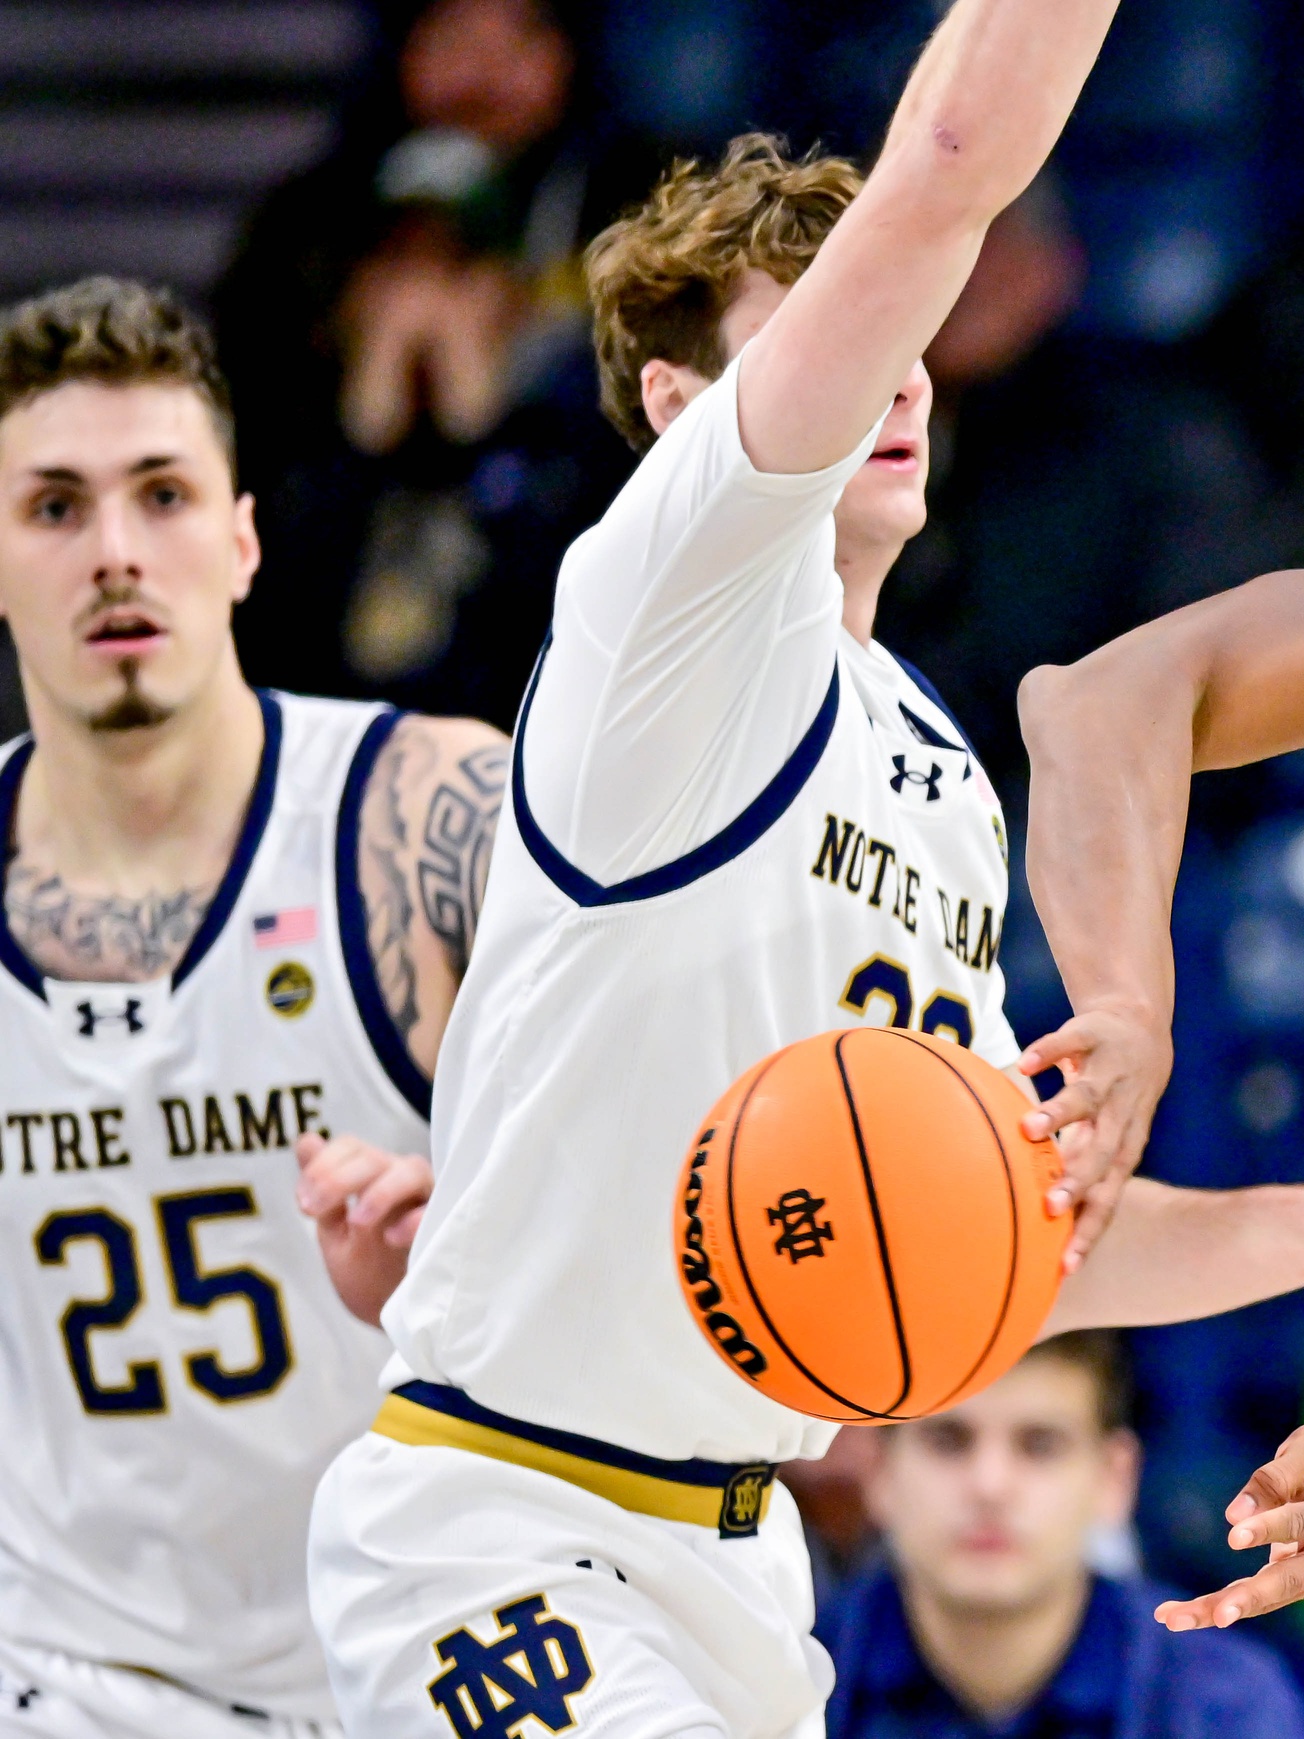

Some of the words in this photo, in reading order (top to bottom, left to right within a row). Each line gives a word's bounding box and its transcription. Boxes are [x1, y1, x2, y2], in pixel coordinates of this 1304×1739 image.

[0, 1107, 130, 1174] TRE
[160, 1083, 332, 1158] DAME
[33, 1184, 296, 1418] 25
